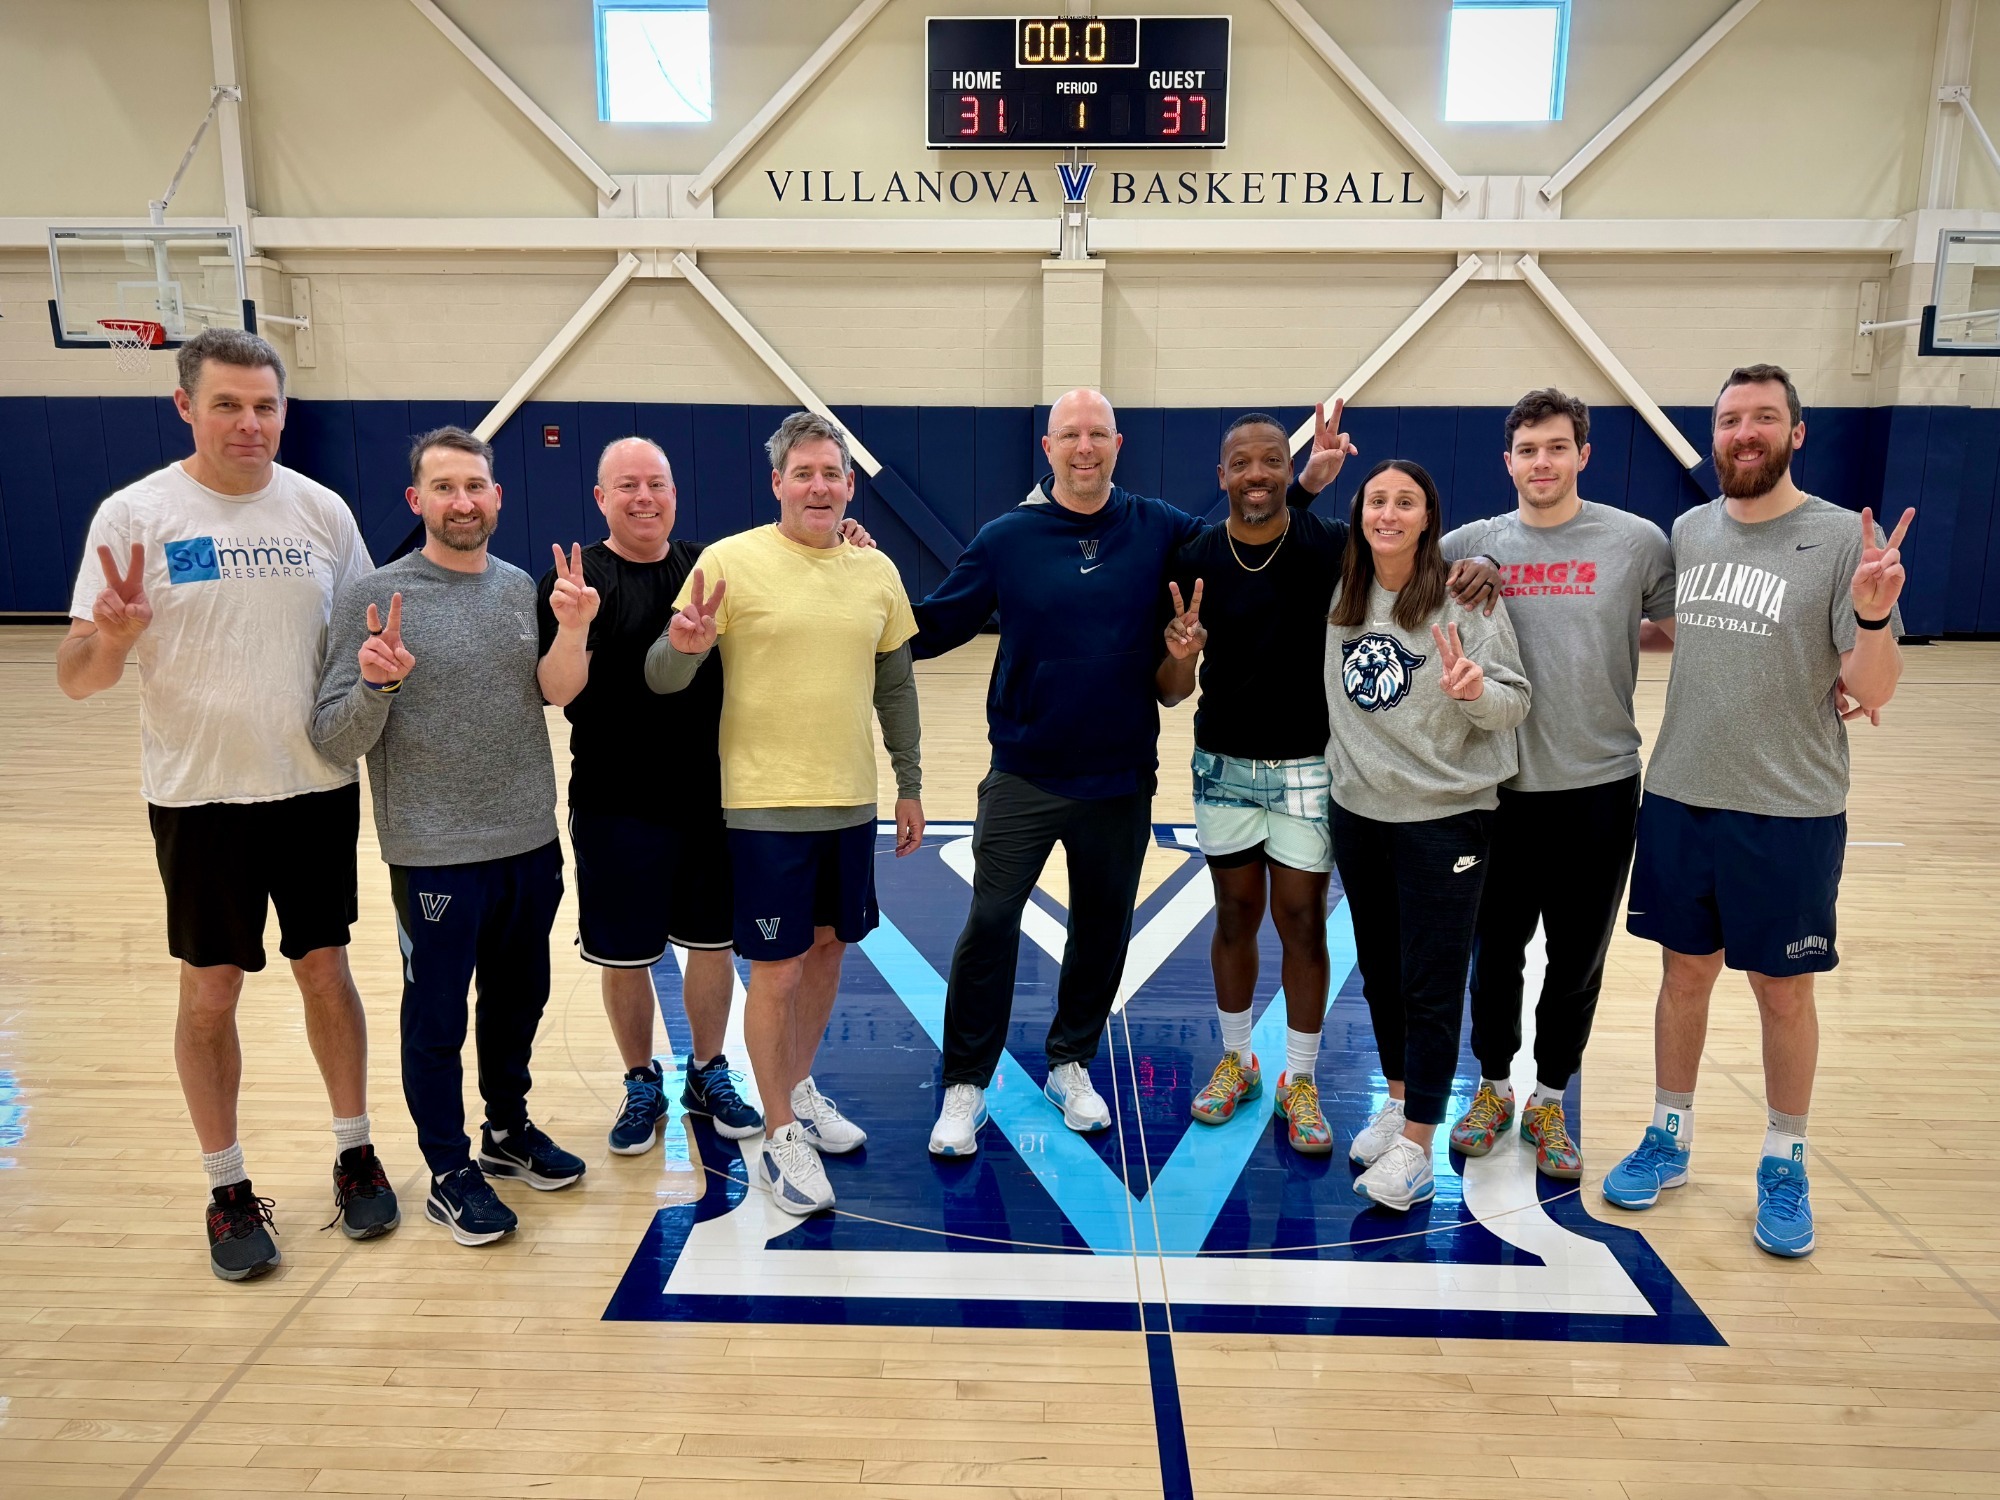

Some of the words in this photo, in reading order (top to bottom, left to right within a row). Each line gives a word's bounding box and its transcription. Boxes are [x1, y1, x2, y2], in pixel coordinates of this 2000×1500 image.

[952, 71, 1002, 90] HOME
[1056, 81, 1098, 95] PERIOD
[1149, 70, 1206, 90] GUEST
[960, 95, 1005, 134] 31
[1078, 101, 1086, 129] 1
[1162, 95, 1207, 134] 37
[764, 170, 1039, 203] VILLANOVA
[1109, 171, 1425, 205] BASKETBALL
[214, 537, 313, 550] VILLANOVA
[222, 567, 315, 579] RESEARCH
[1675, 563, 1788, 624] VILLANOVA
[1457, 855, 1477, 866] NIKE
[1786, 935, 1828, 955] VILLANOVA
